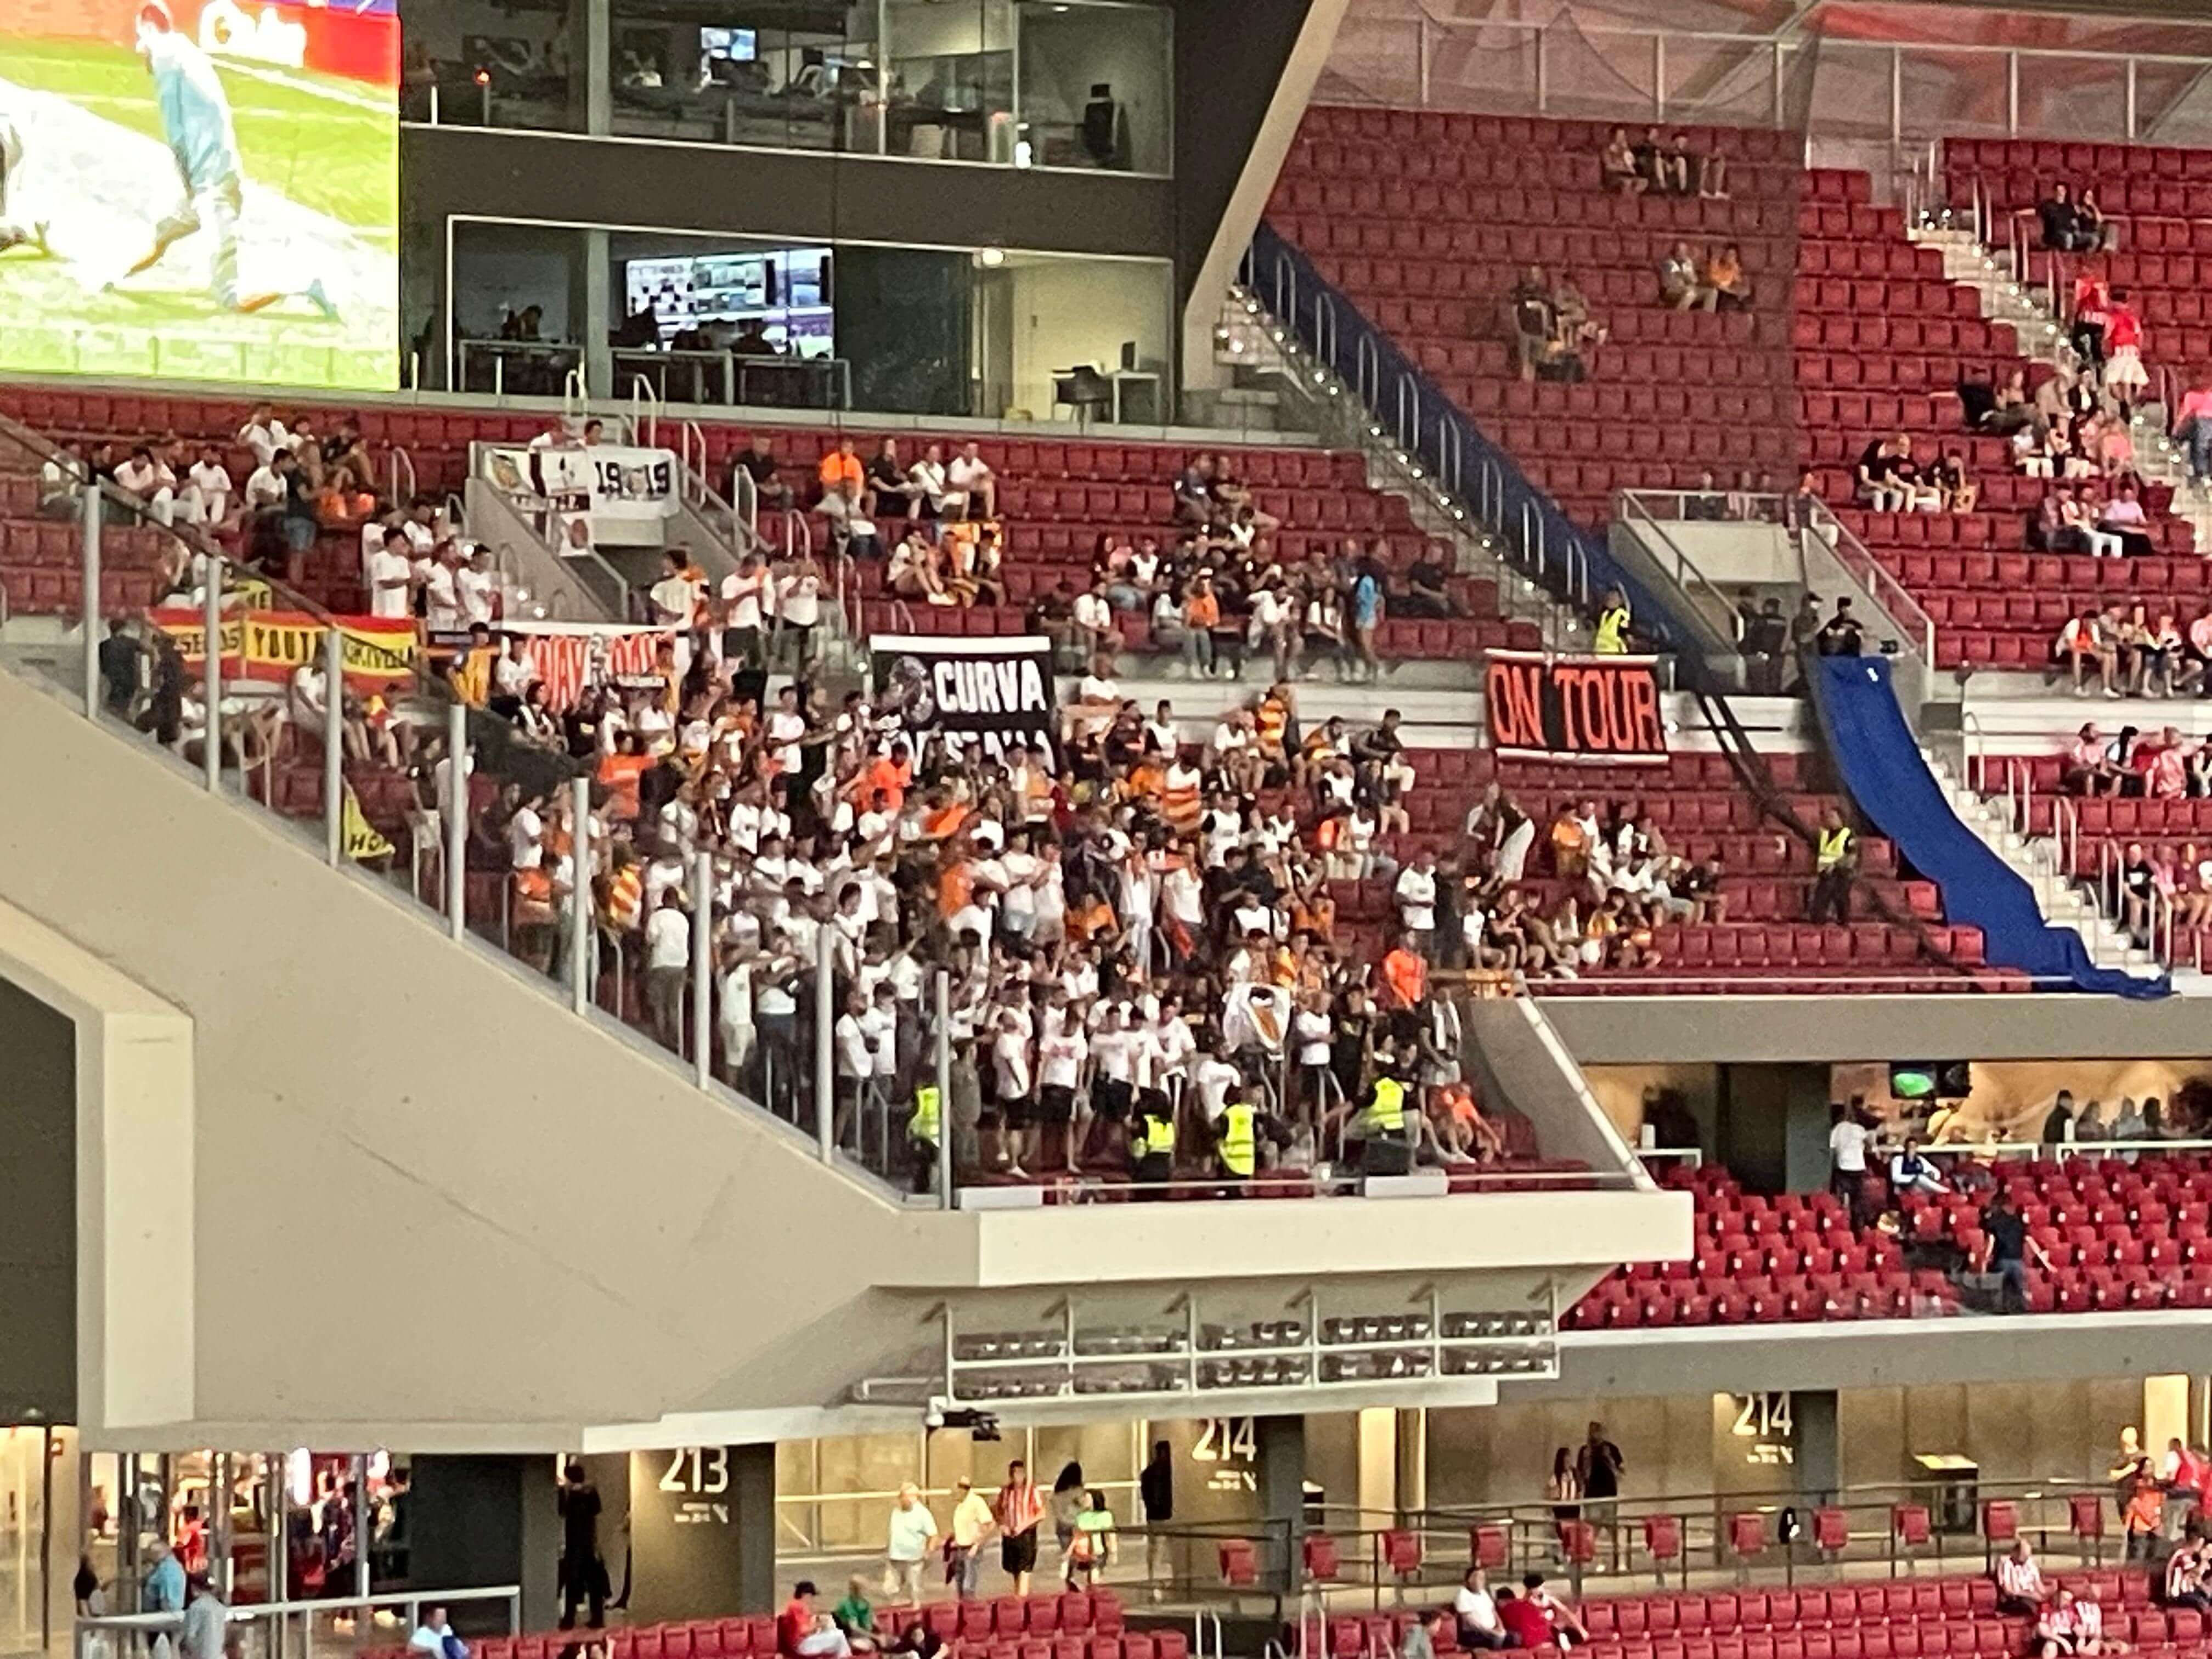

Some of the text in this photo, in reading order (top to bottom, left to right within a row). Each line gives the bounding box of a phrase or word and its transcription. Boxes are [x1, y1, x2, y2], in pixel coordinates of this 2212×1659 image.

[933, 659, 1047, 713] CURVA
[1489, 663, 1664, 752] ON TOUR
[1732, 1391, 1793, 1436] 214
[1192, 1417, 1257, 1462] 214
[658, 1447, 729, 1493] 213
